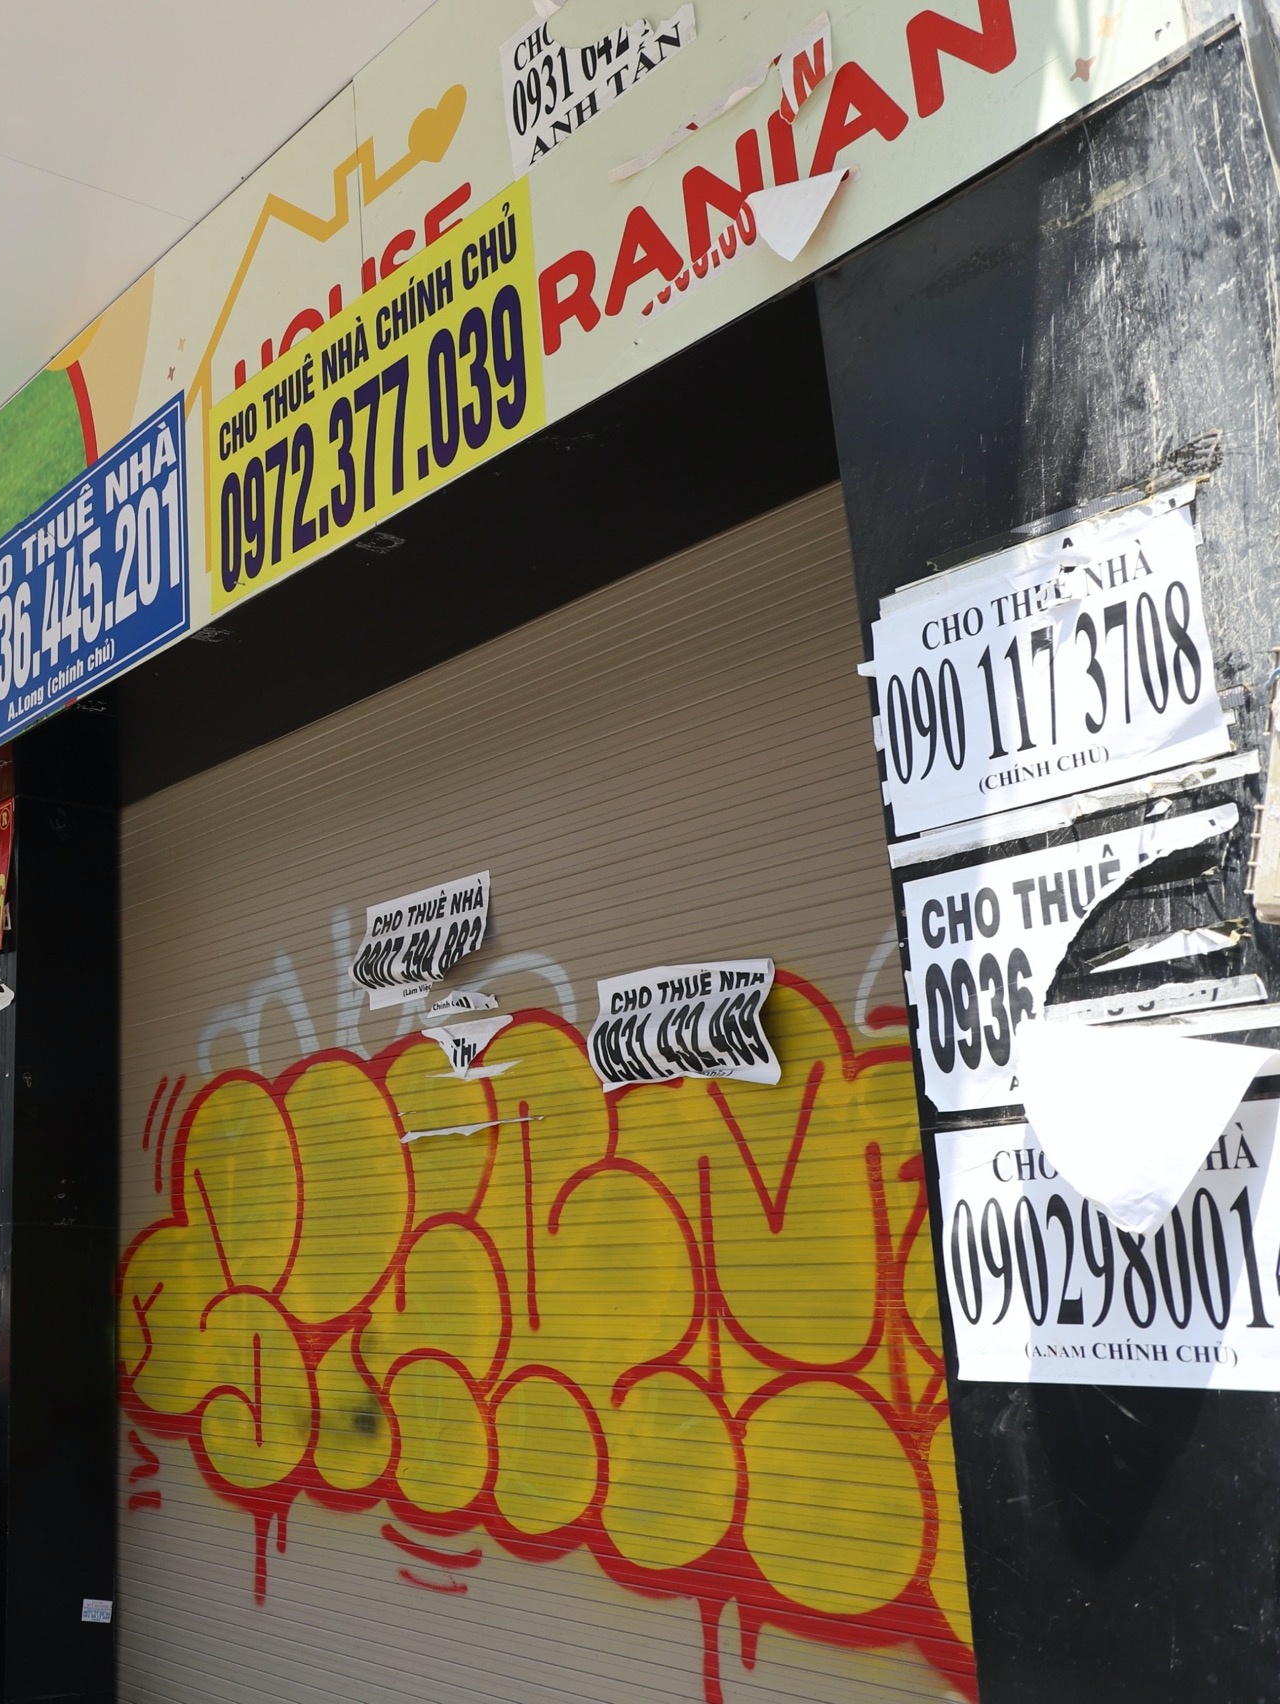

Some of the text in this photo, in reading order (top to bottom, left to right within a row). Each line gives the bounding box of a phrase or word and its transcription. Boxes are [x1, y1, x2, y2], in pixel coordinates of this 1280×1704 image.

[529, 88, 600, 166] ANH
[219, 201, 517, 461] CHO THUÊ NHÀ CHÍNH CHỦ
[220, 284, 527, 594] 0972.377.039
[22, 483, 94, 575] THUÊ
[105, 421, 177, 514] NHÀ
[921, 607, 984, 651] CHO
[1082, 538, 1154, 596] NHÀ
[7, 638, 116, 722] A.Long (chính chủ)
[979, 745, 1110, 795] (CHÍNH CHỦ)
[372, 879, 484, 938] CHO THUÊ NHÀ
[921, 887, 1001, 949] CHO
[403, 987, 418, 997] (Làm
[432, 1001, 450, 1011] Chính
[611, 986, 652, 1015] CHO
[593, 990, 769, 1083] 0931.432.469
[950, 1184, 1280, 1331] 090298001
[1024, 1337, 1239, 1368] (A.NAM CHÍNH CHỦ)
